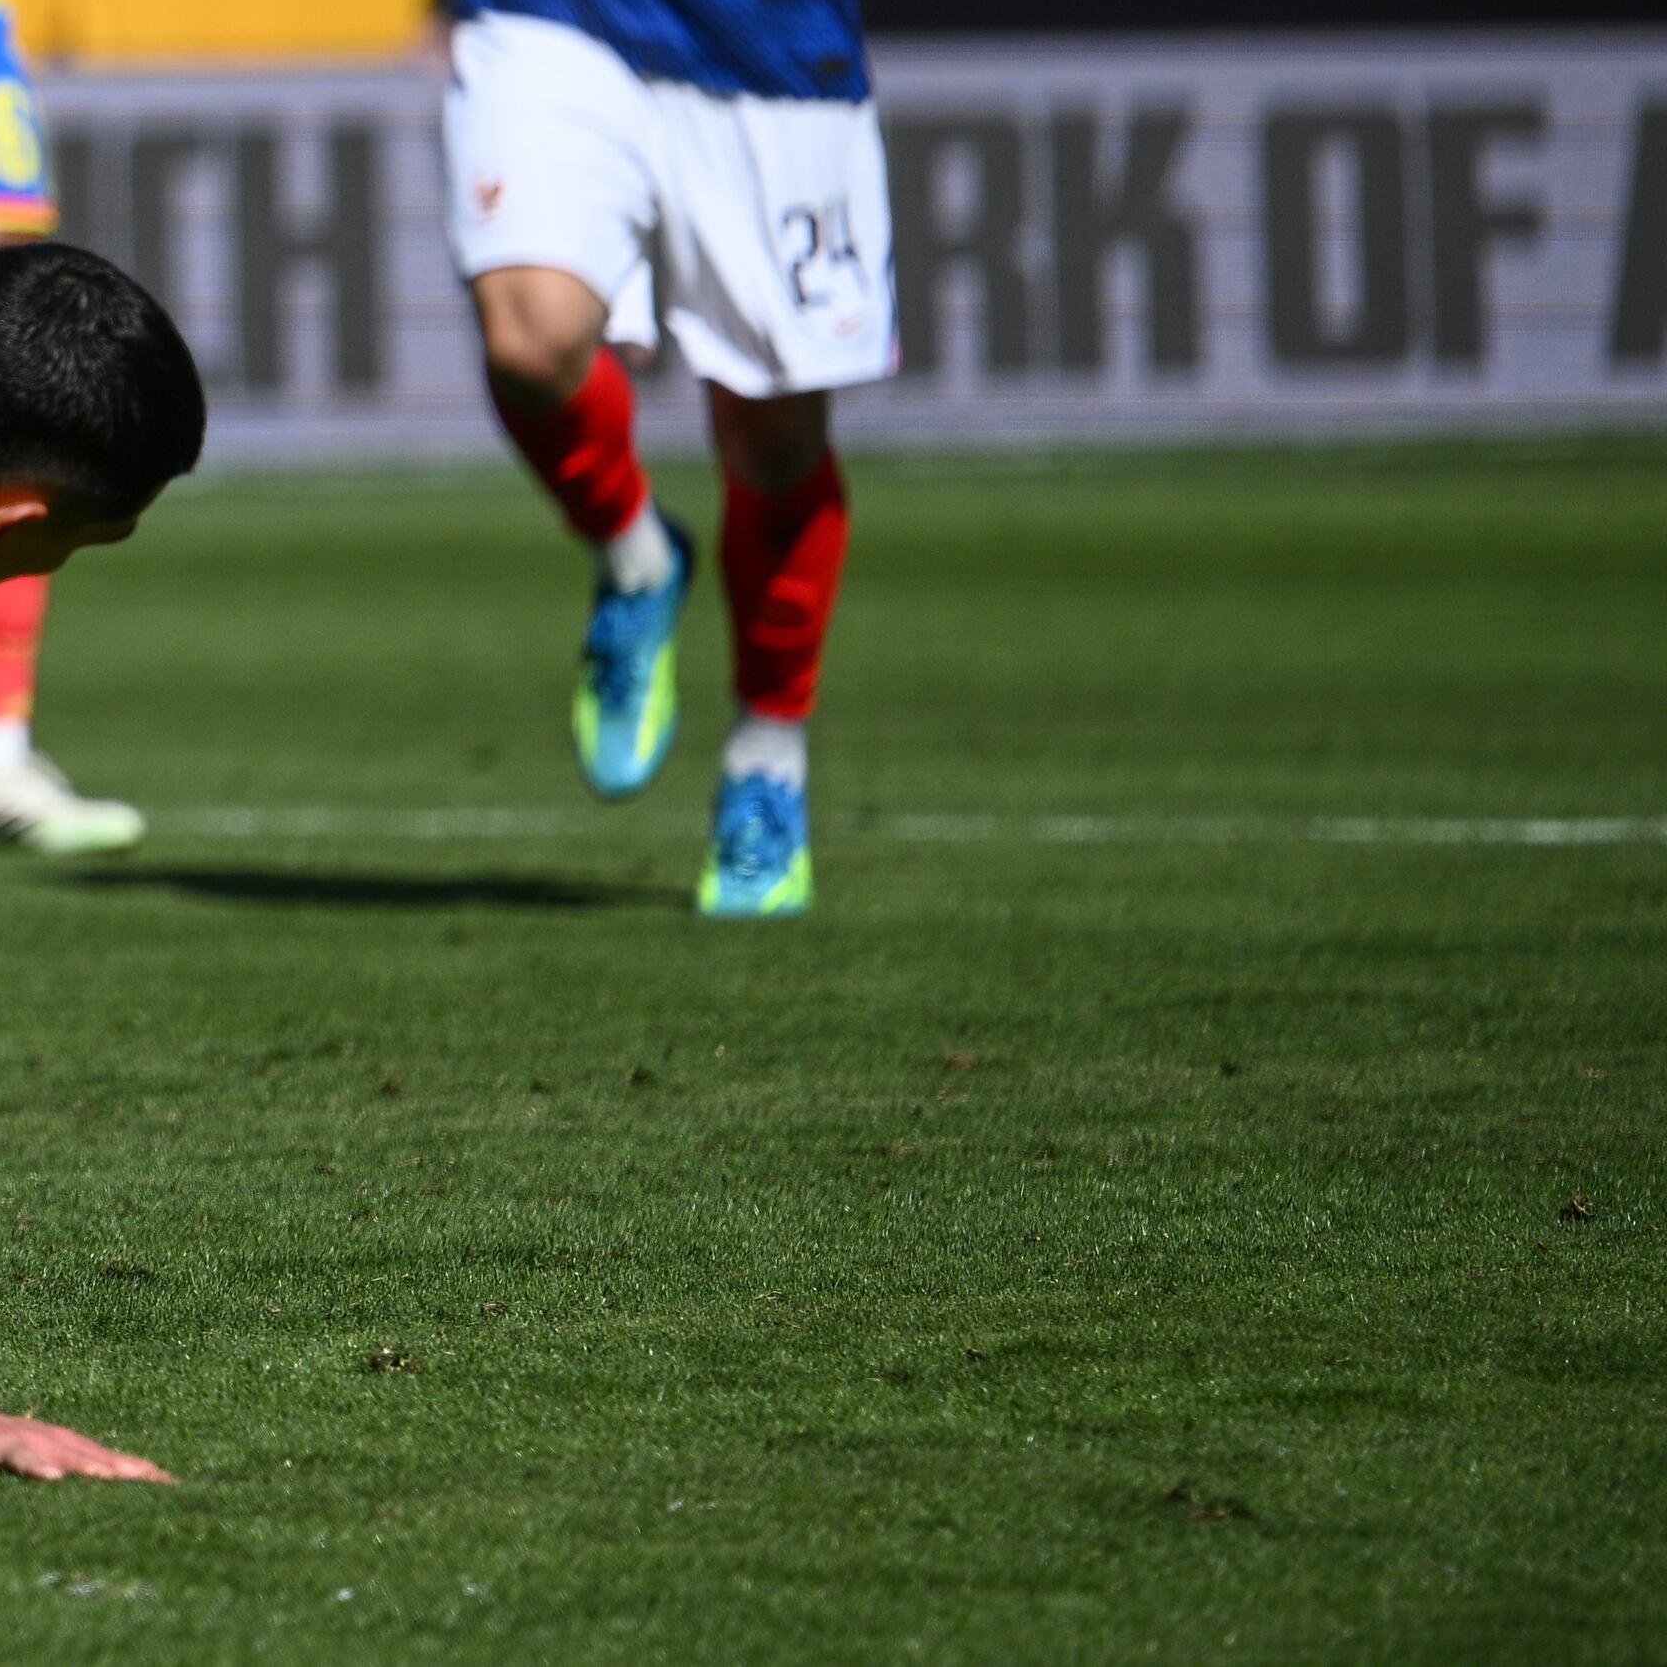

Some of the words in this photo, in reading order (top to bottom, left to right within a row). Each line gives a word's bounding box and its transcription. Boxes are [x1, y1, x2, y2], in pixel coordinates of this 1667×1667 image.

[779, 194, 871, 312] 24
[885, 92, 1205, 374] RK
[1261, 89, 1549, 376] OF
